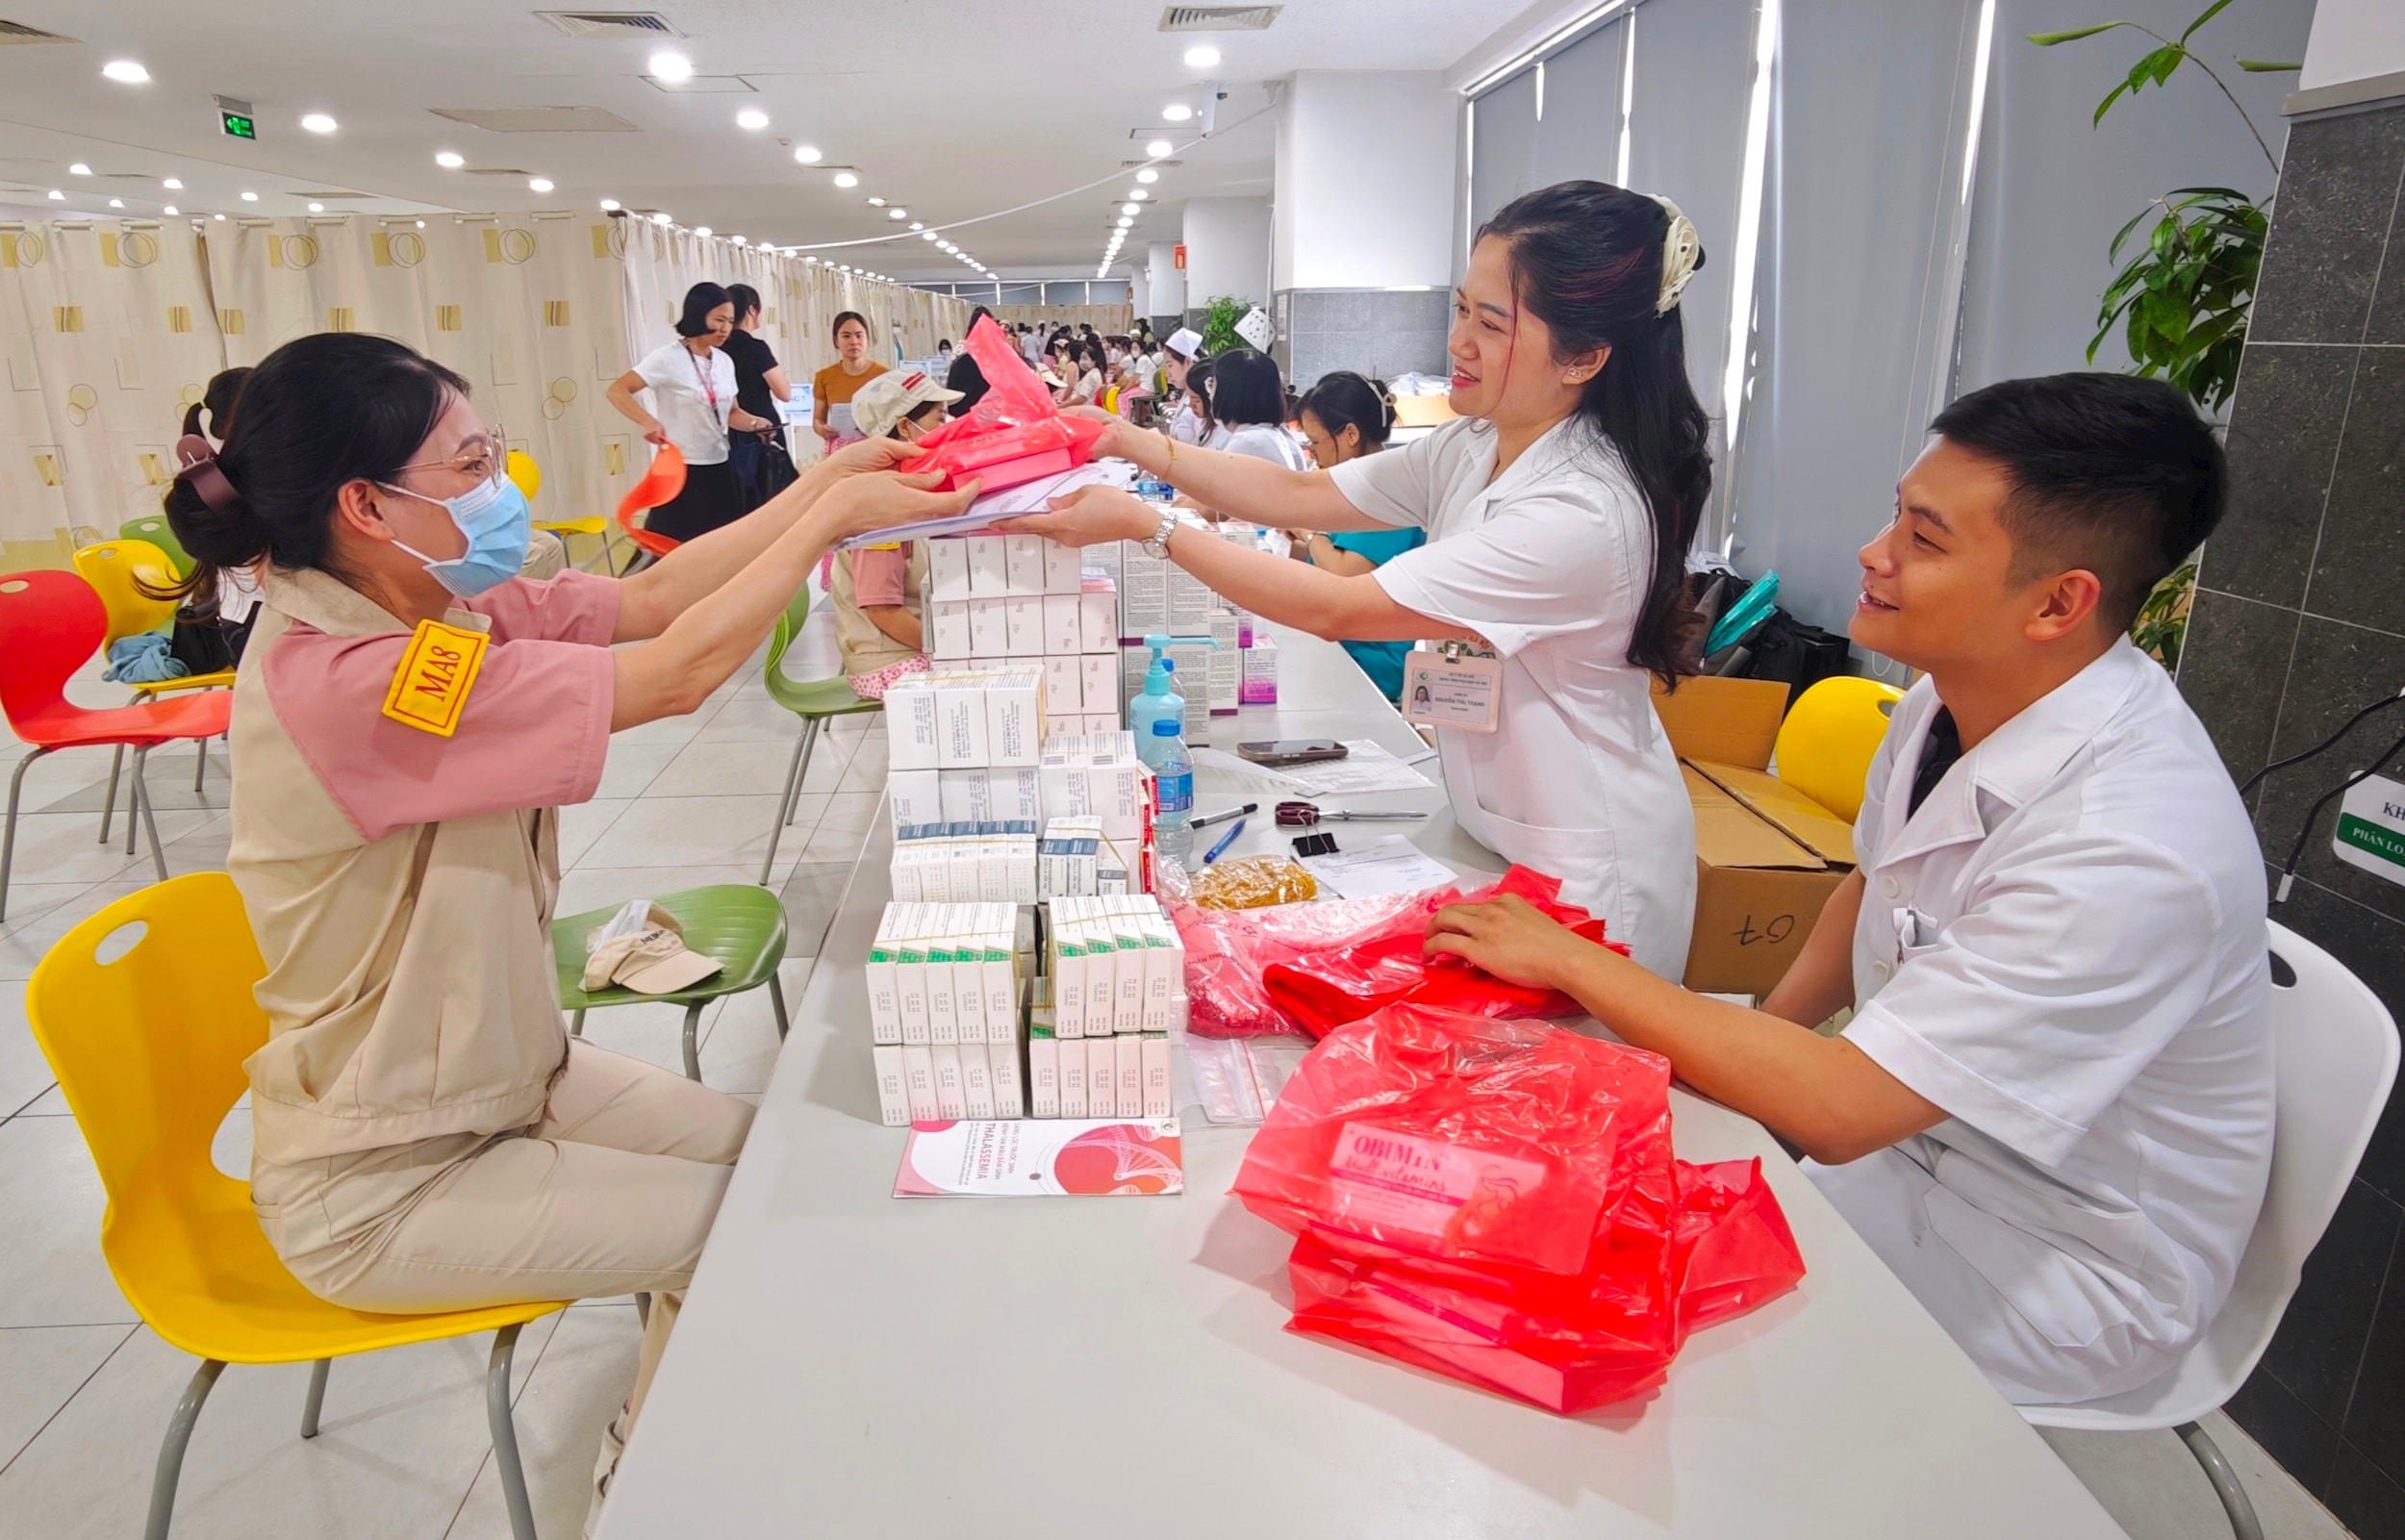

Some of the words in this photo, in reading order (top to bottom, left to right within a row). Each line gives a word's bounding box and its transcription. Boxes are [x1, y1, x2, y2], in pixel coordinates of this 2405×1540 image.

[415, 645, 461, 702] MA8
[2352, 827, 2385, 846] PHÂN
[2386, 841, 2405, 859] LO
[976, 1123, 996, 1179] THALASSEMIA
